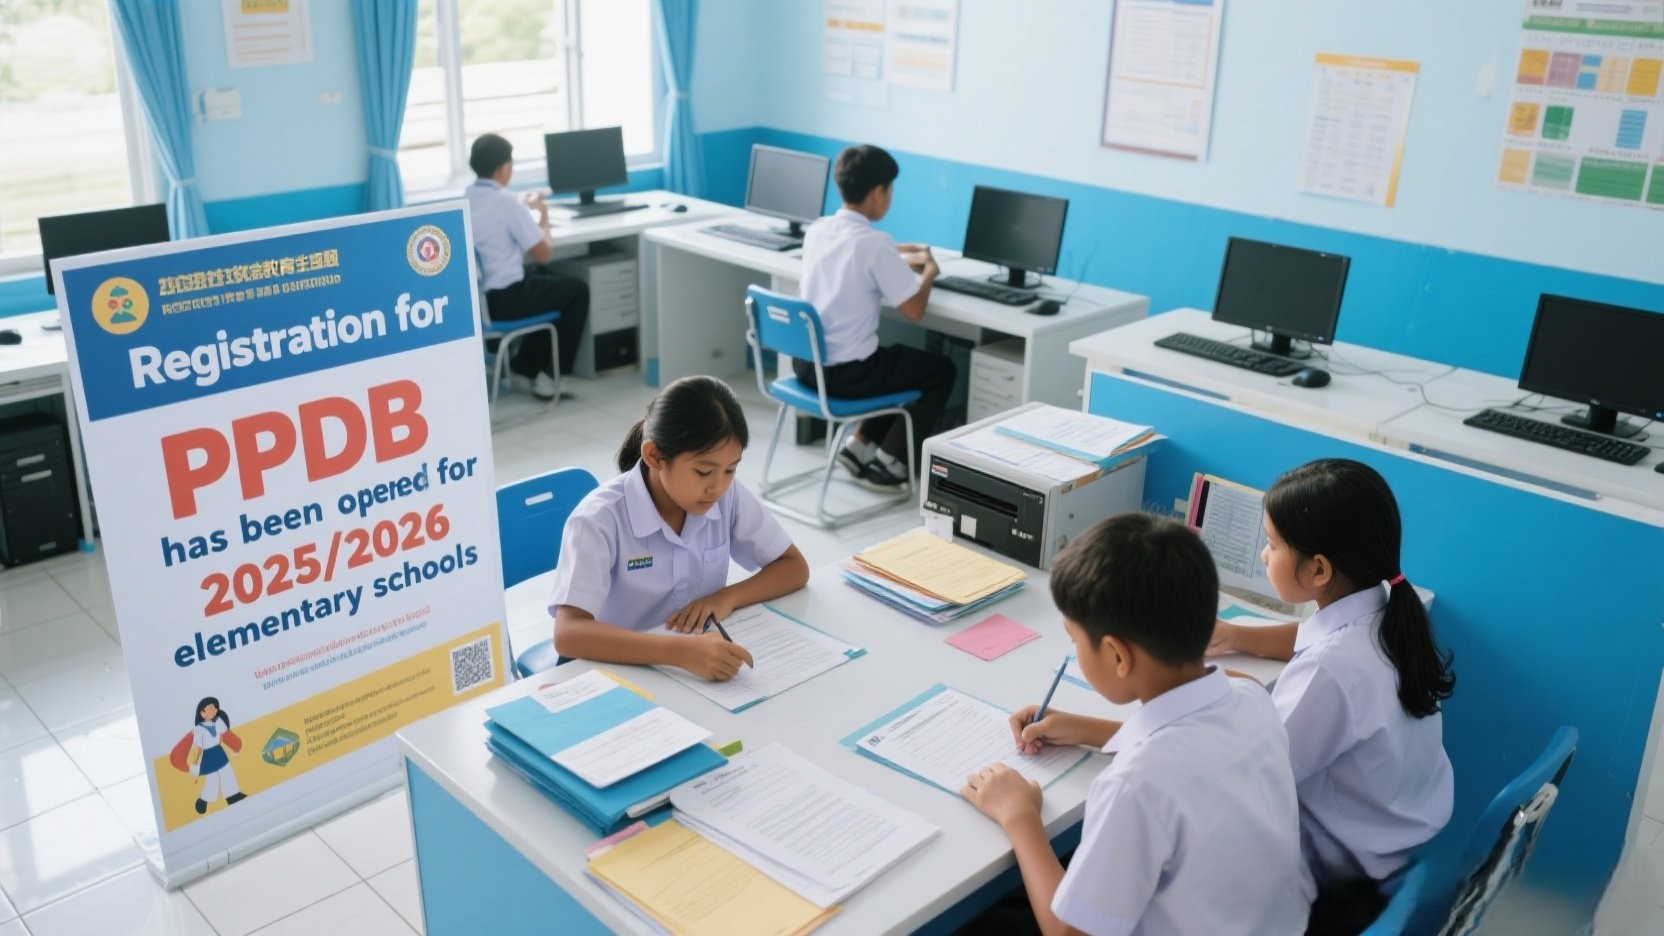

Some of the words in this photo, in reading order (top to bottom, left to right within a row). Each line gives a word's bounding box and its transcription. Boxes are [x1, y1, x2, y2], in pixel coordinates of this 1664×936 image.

[129, 309, 387, 388] Registration
[394, 292, 449, 332] for
[161, 379, 429, 519] PPDB
[160, 529, 229, 568] has
[239, 502, 324, 545] been
[436, 456, 479, 485] for
[201, 504, 450, 616] 2025/2026
[174, 585, 363, 668] elementary
[373, 543, 479, 598] schools
